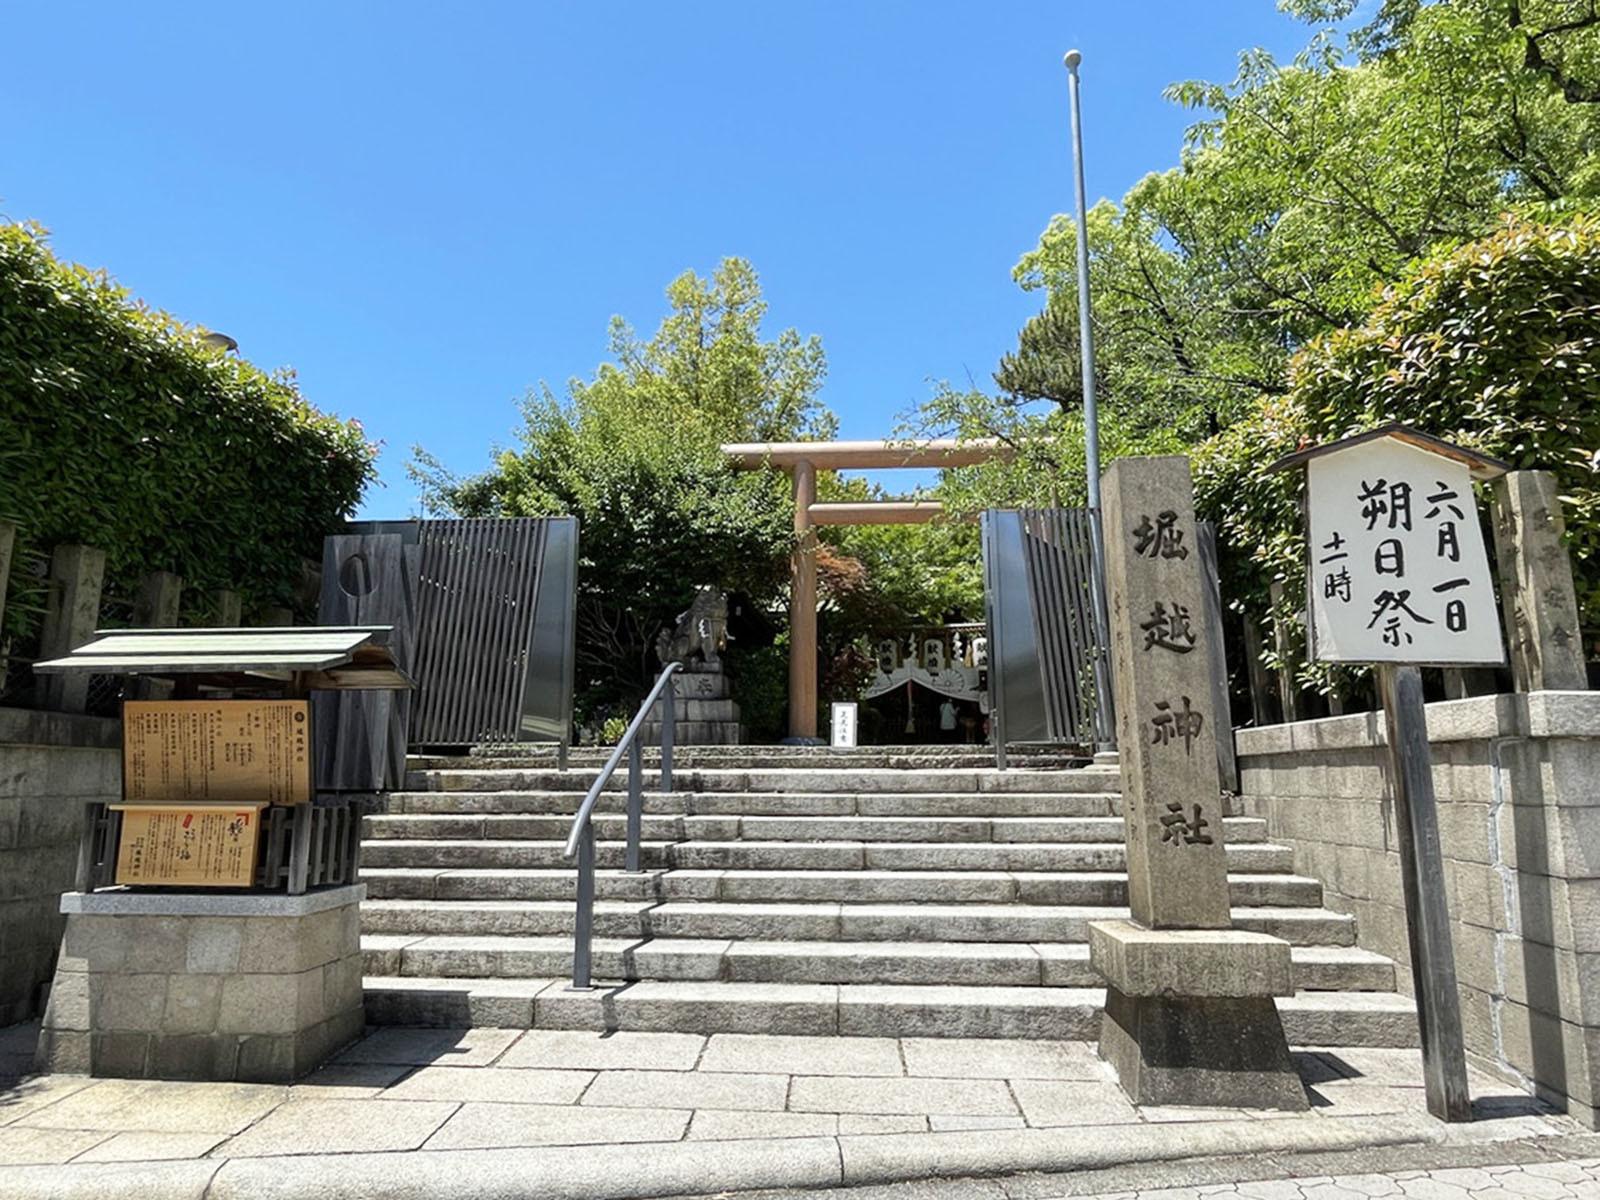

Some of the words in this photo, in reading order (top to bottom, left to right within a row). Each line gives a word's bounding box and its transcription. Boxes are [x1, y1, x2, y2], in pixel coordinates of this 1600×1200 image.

[1319, 531, 1352, 603] 十一時
[1357, 478, 1434, 647] 朔日祭
[1424, 481, 1471, 633] 六月一日
[1132, 509, 1214, 847] 堀越神社
